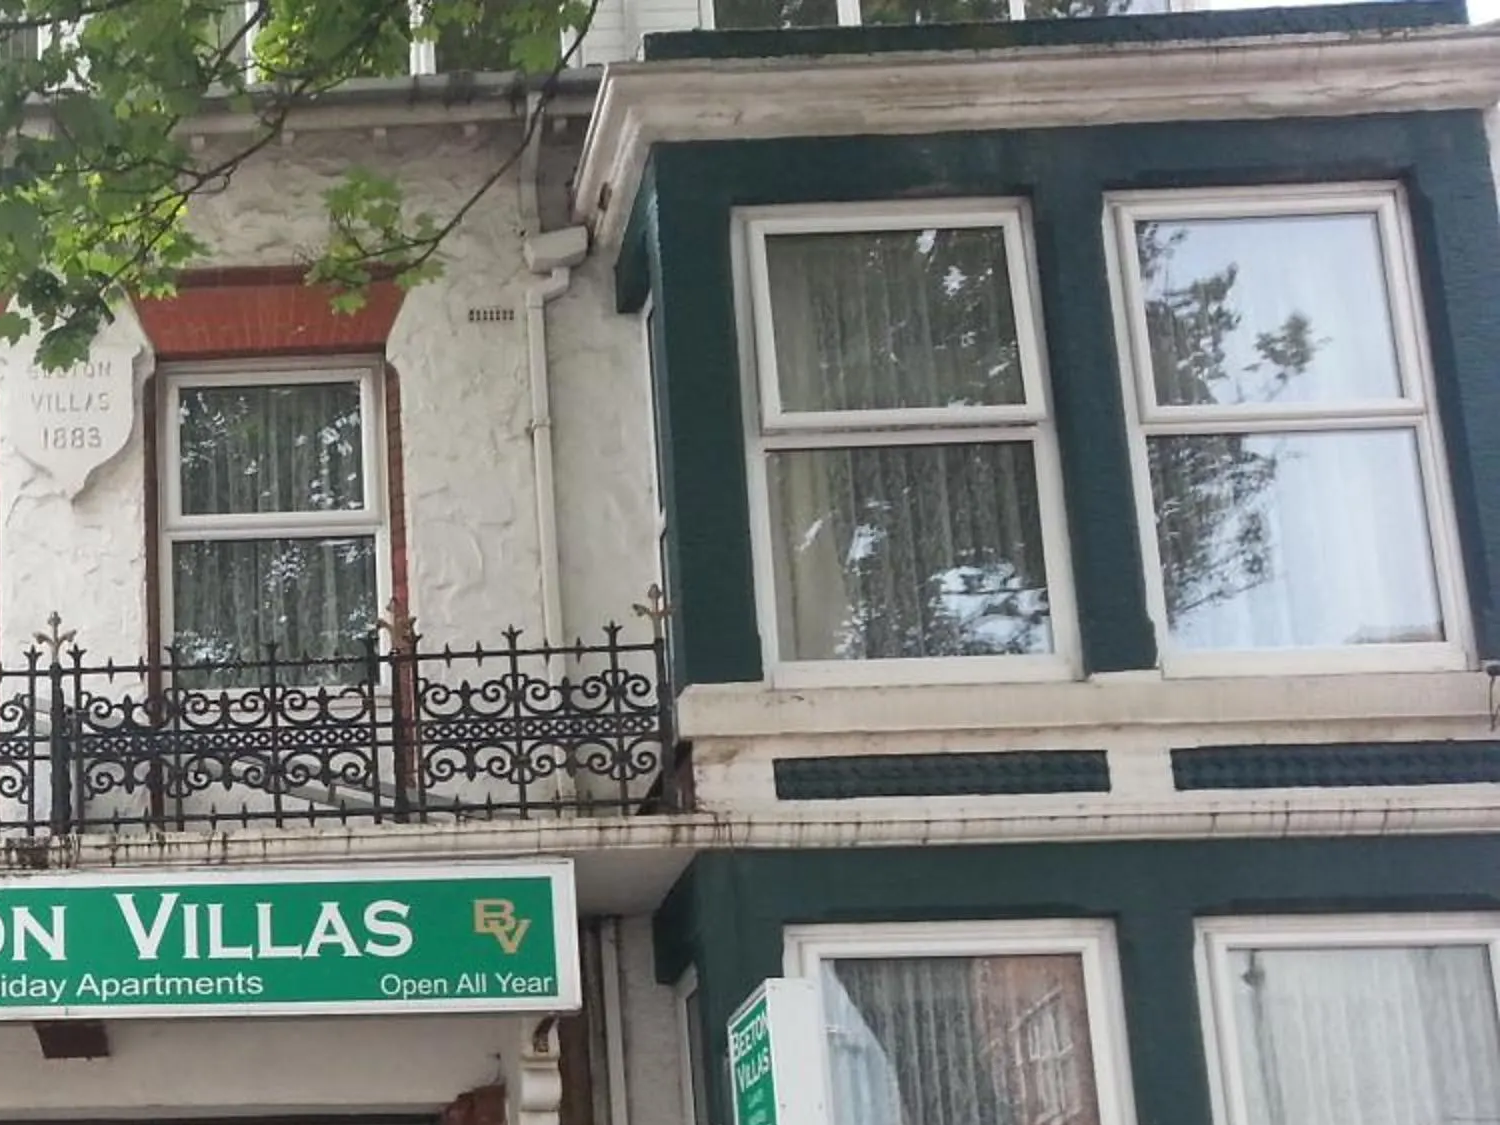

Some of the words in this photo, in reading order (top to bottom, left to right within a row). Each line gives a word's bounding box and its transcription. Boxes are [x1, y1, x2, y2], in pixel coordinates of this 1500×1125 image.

[43, 426, 102, 449] 1883
[113, 892, 414, 960] VILLAS
[76, 972, 264, 1002] Apartments
[380, 974, 448, 996] Open
[457, 973, 488, 994] All
[495, 972, 553, 994] Year
